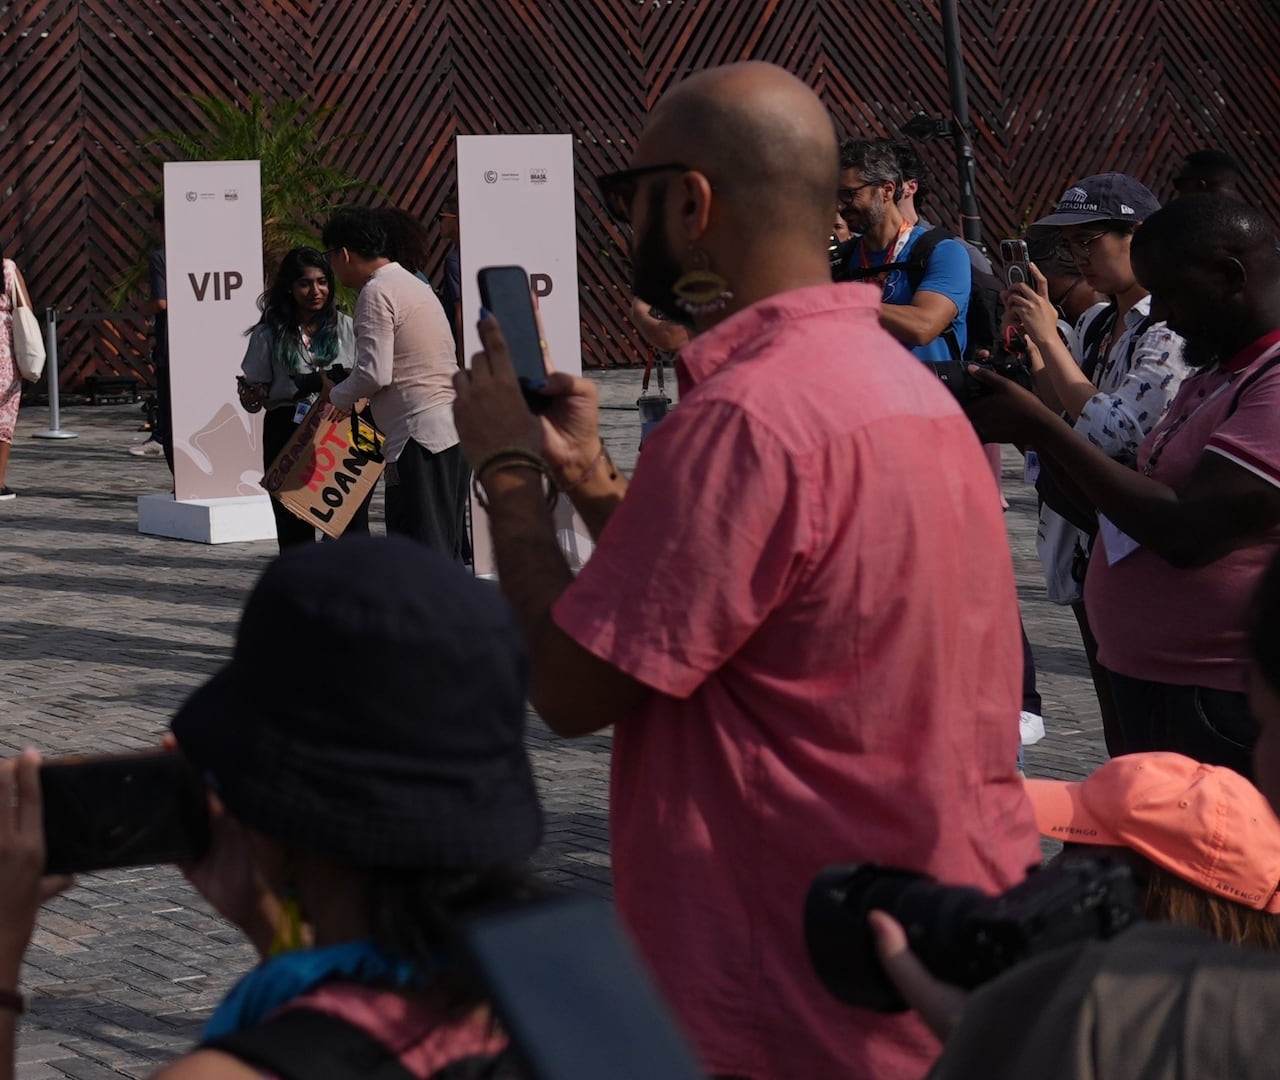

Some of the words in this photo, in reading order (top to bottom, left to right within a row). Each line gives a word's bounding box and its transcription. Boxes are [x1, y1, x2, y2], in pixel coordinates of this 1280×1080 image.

[188, 271, 243, 301] VIP
[299, 423, 348, 493] NOT
[1051, 826, 1097, 837] ARTENGO
[1215, 882, 1262, 902] ARTENGO
